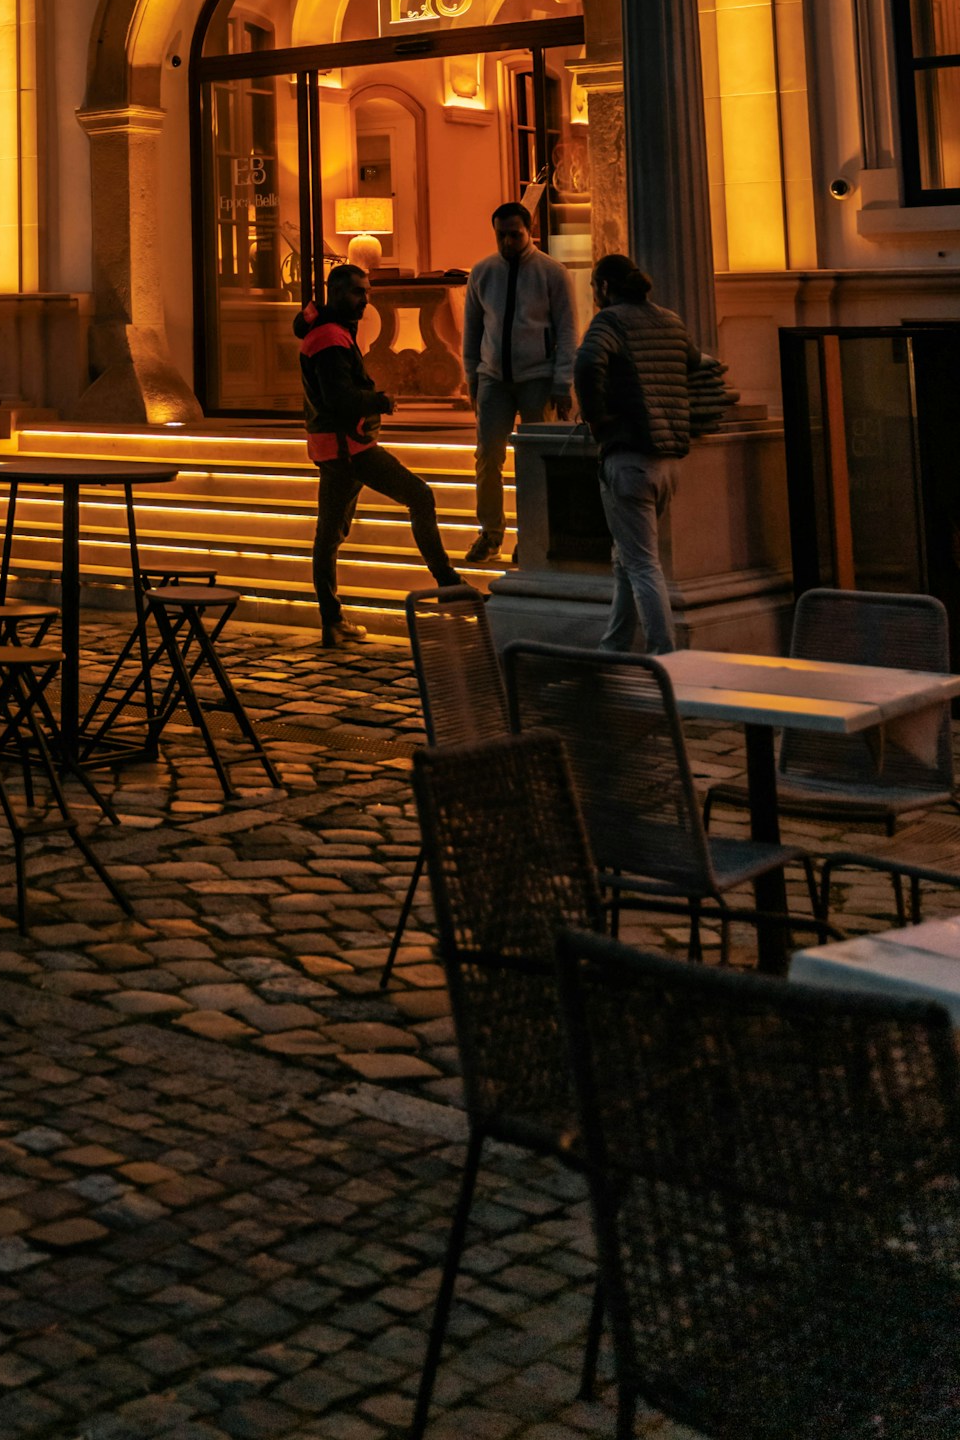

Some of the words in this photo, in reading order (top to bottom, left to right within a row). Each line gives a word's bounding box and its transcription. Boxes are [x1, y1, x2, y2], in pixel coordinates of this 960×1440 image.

[233, 157, 267, 186] EB
[220, 195, 250, 212] Epoca
[255, 193, 281, 208] Bella
